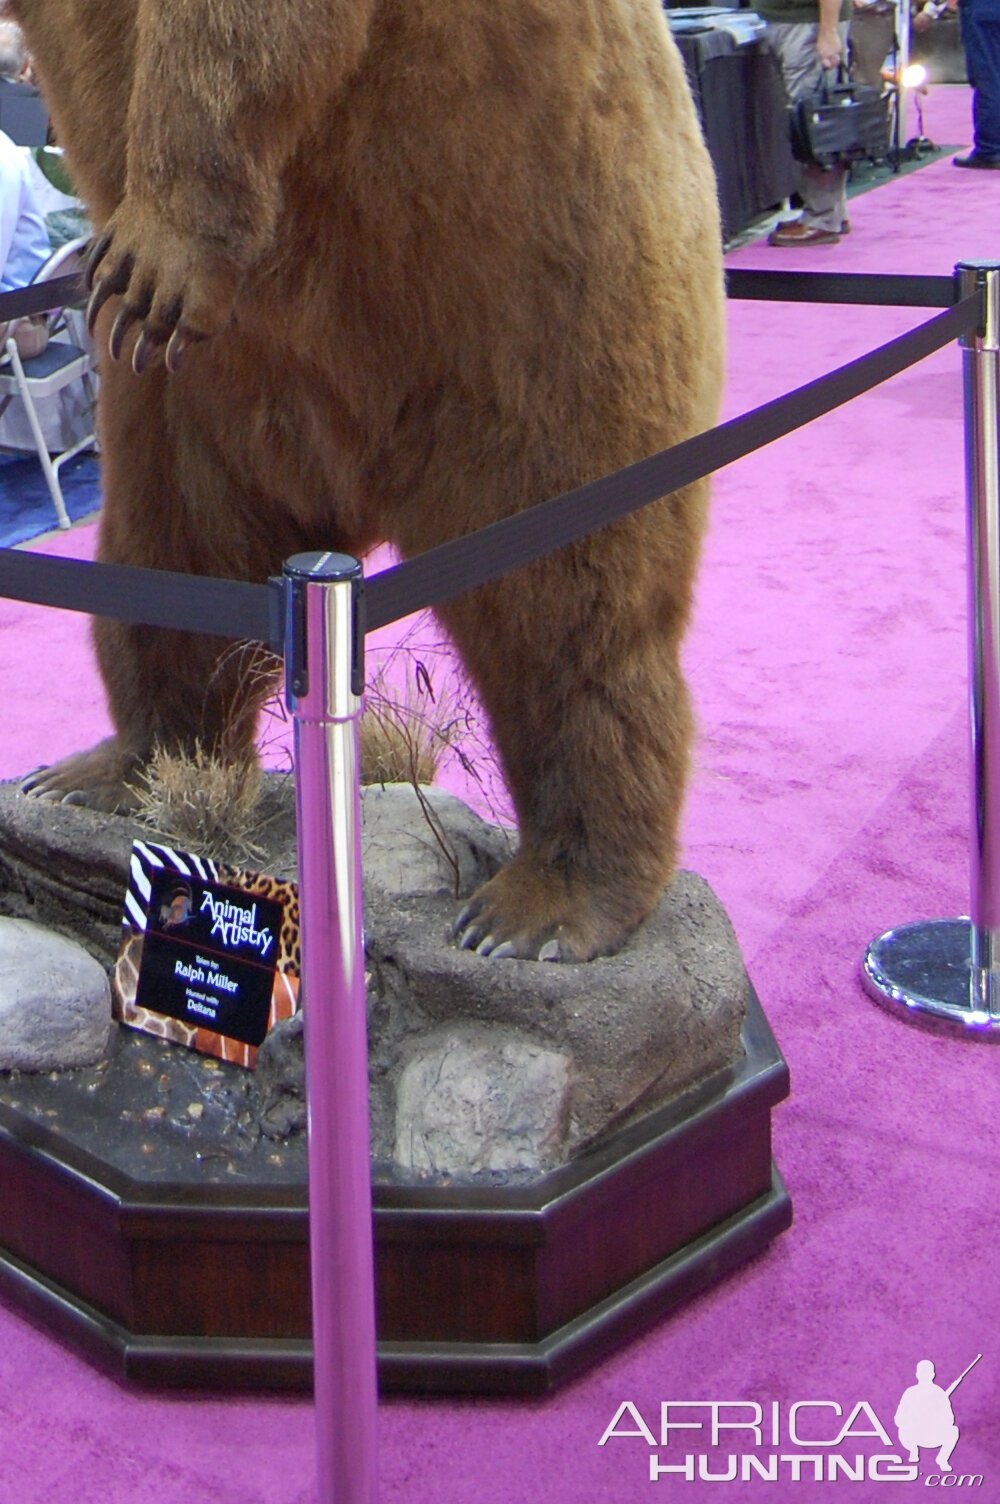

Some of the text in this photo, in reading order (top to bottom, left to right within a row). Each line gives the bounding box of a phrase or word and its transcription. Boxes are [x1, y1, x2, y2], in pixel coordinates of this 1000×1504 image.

[200, 890, 257, 925] Animal
[211, 914, 273, 956] Artistry
[175, 960, 239, 993] Ralph Miller
